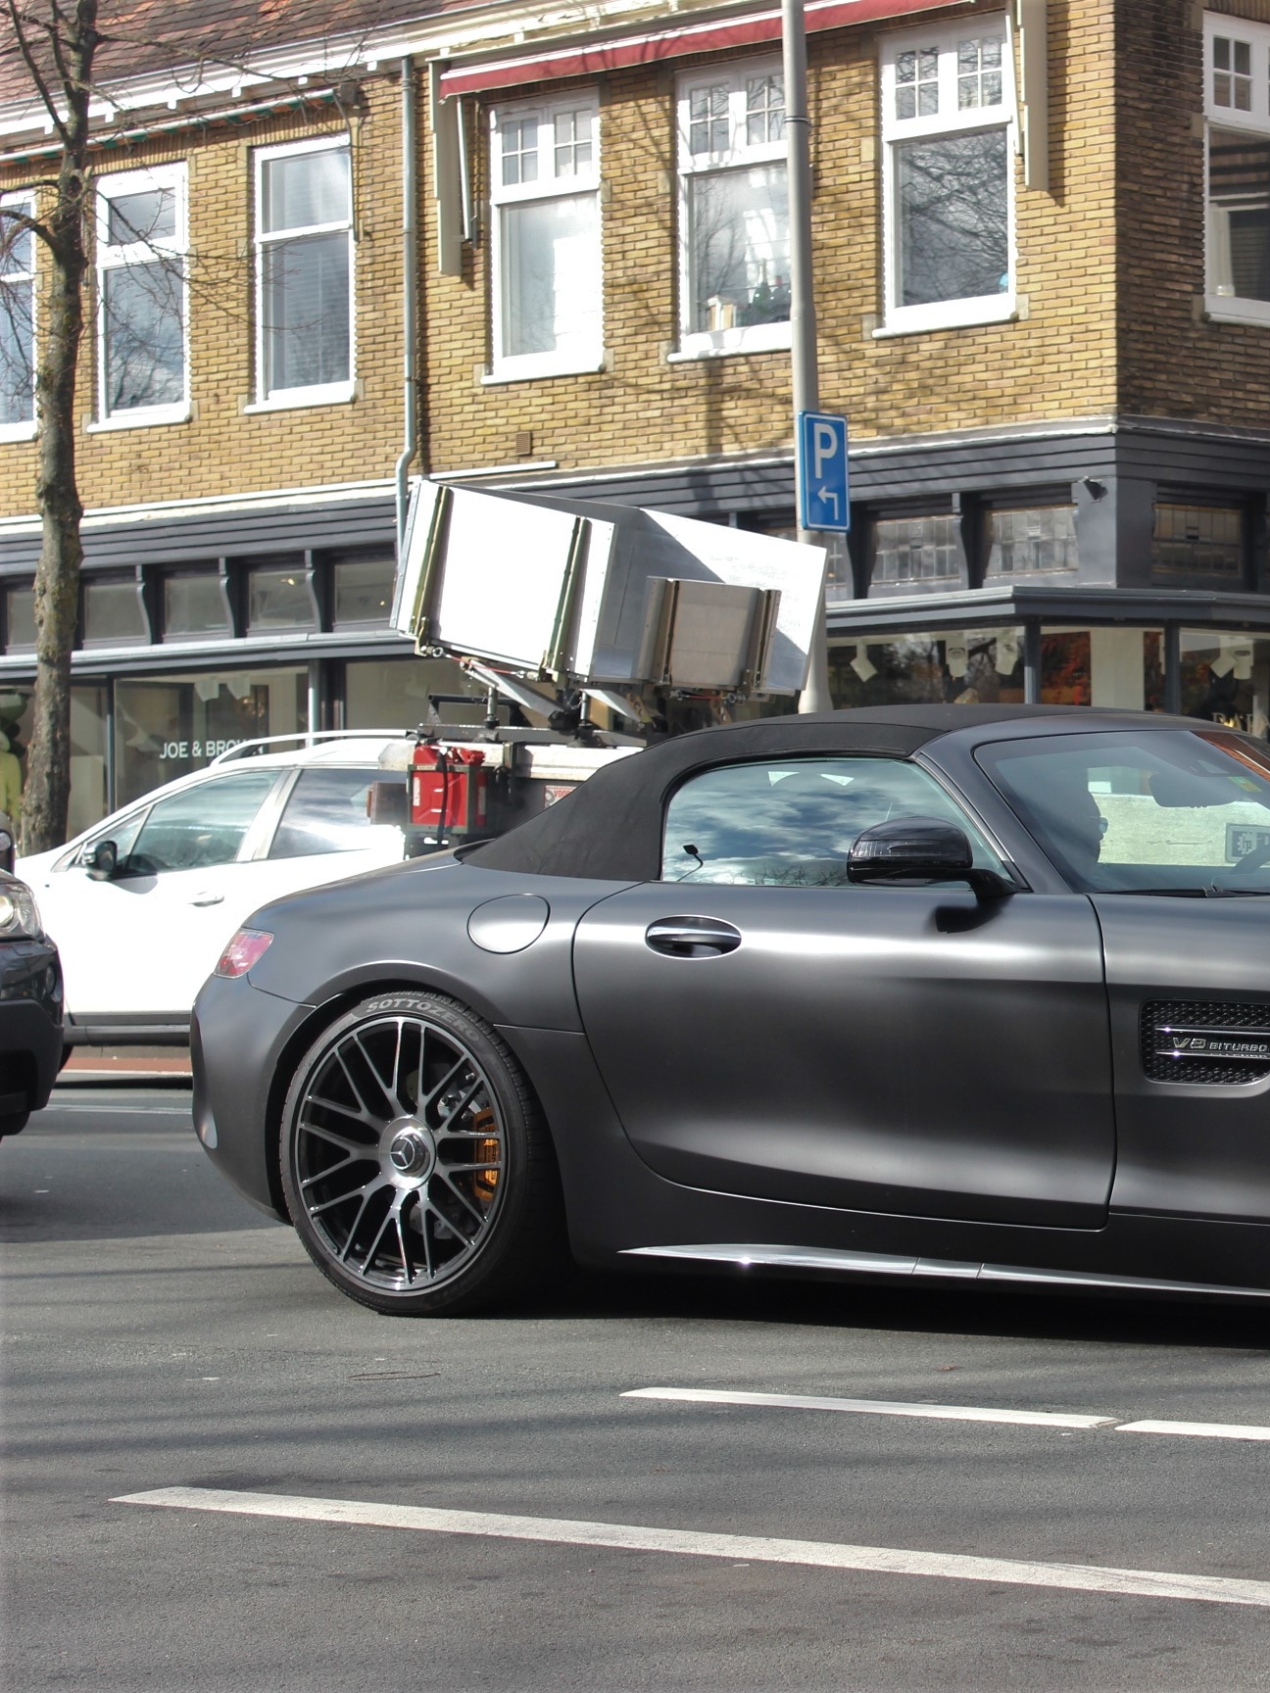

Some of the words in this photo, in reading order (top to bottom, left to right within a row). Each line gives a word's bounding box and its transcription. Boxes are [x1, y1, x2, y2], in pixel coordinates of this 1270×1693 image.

[813, 422, 838, 479] P
[160, 742, 188, 759] JOE
[191, 741, 202, 757] &
[366, 998, 480, 1041] SOTTOZERO
[1172, 1037, 1206, 1049] V8
[1209, 1041, 1268, 1052] BITURBO
